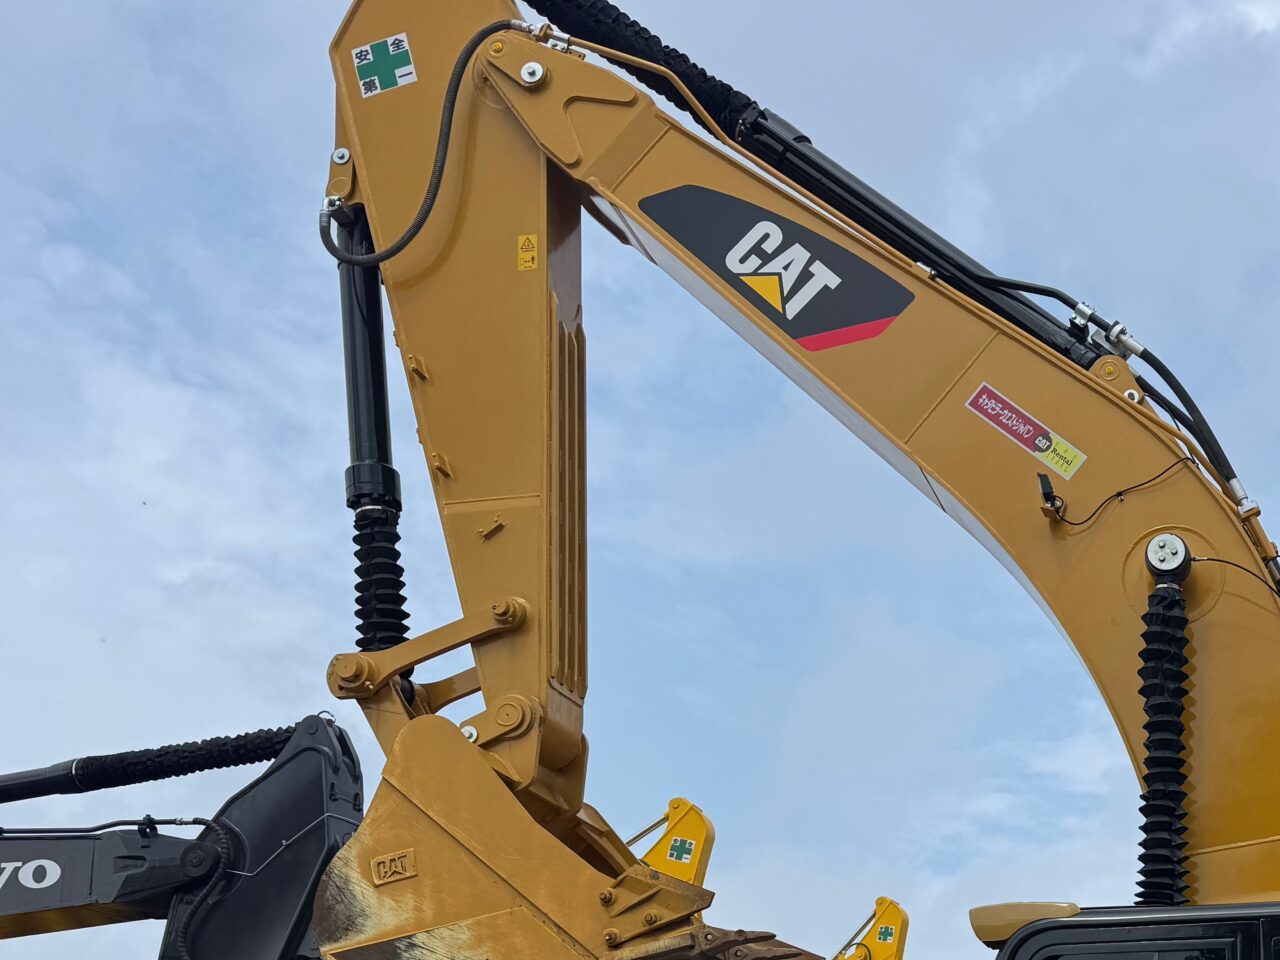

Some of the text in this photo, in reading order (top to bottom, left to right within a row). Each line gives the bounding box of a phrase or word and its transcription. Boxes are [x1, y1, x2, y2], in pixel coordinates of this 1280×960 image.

[725, 220, 843, 321] CAT
[1035, 435, 1051, 450] CAT
[1050, 447, 1074, 468] Rental
